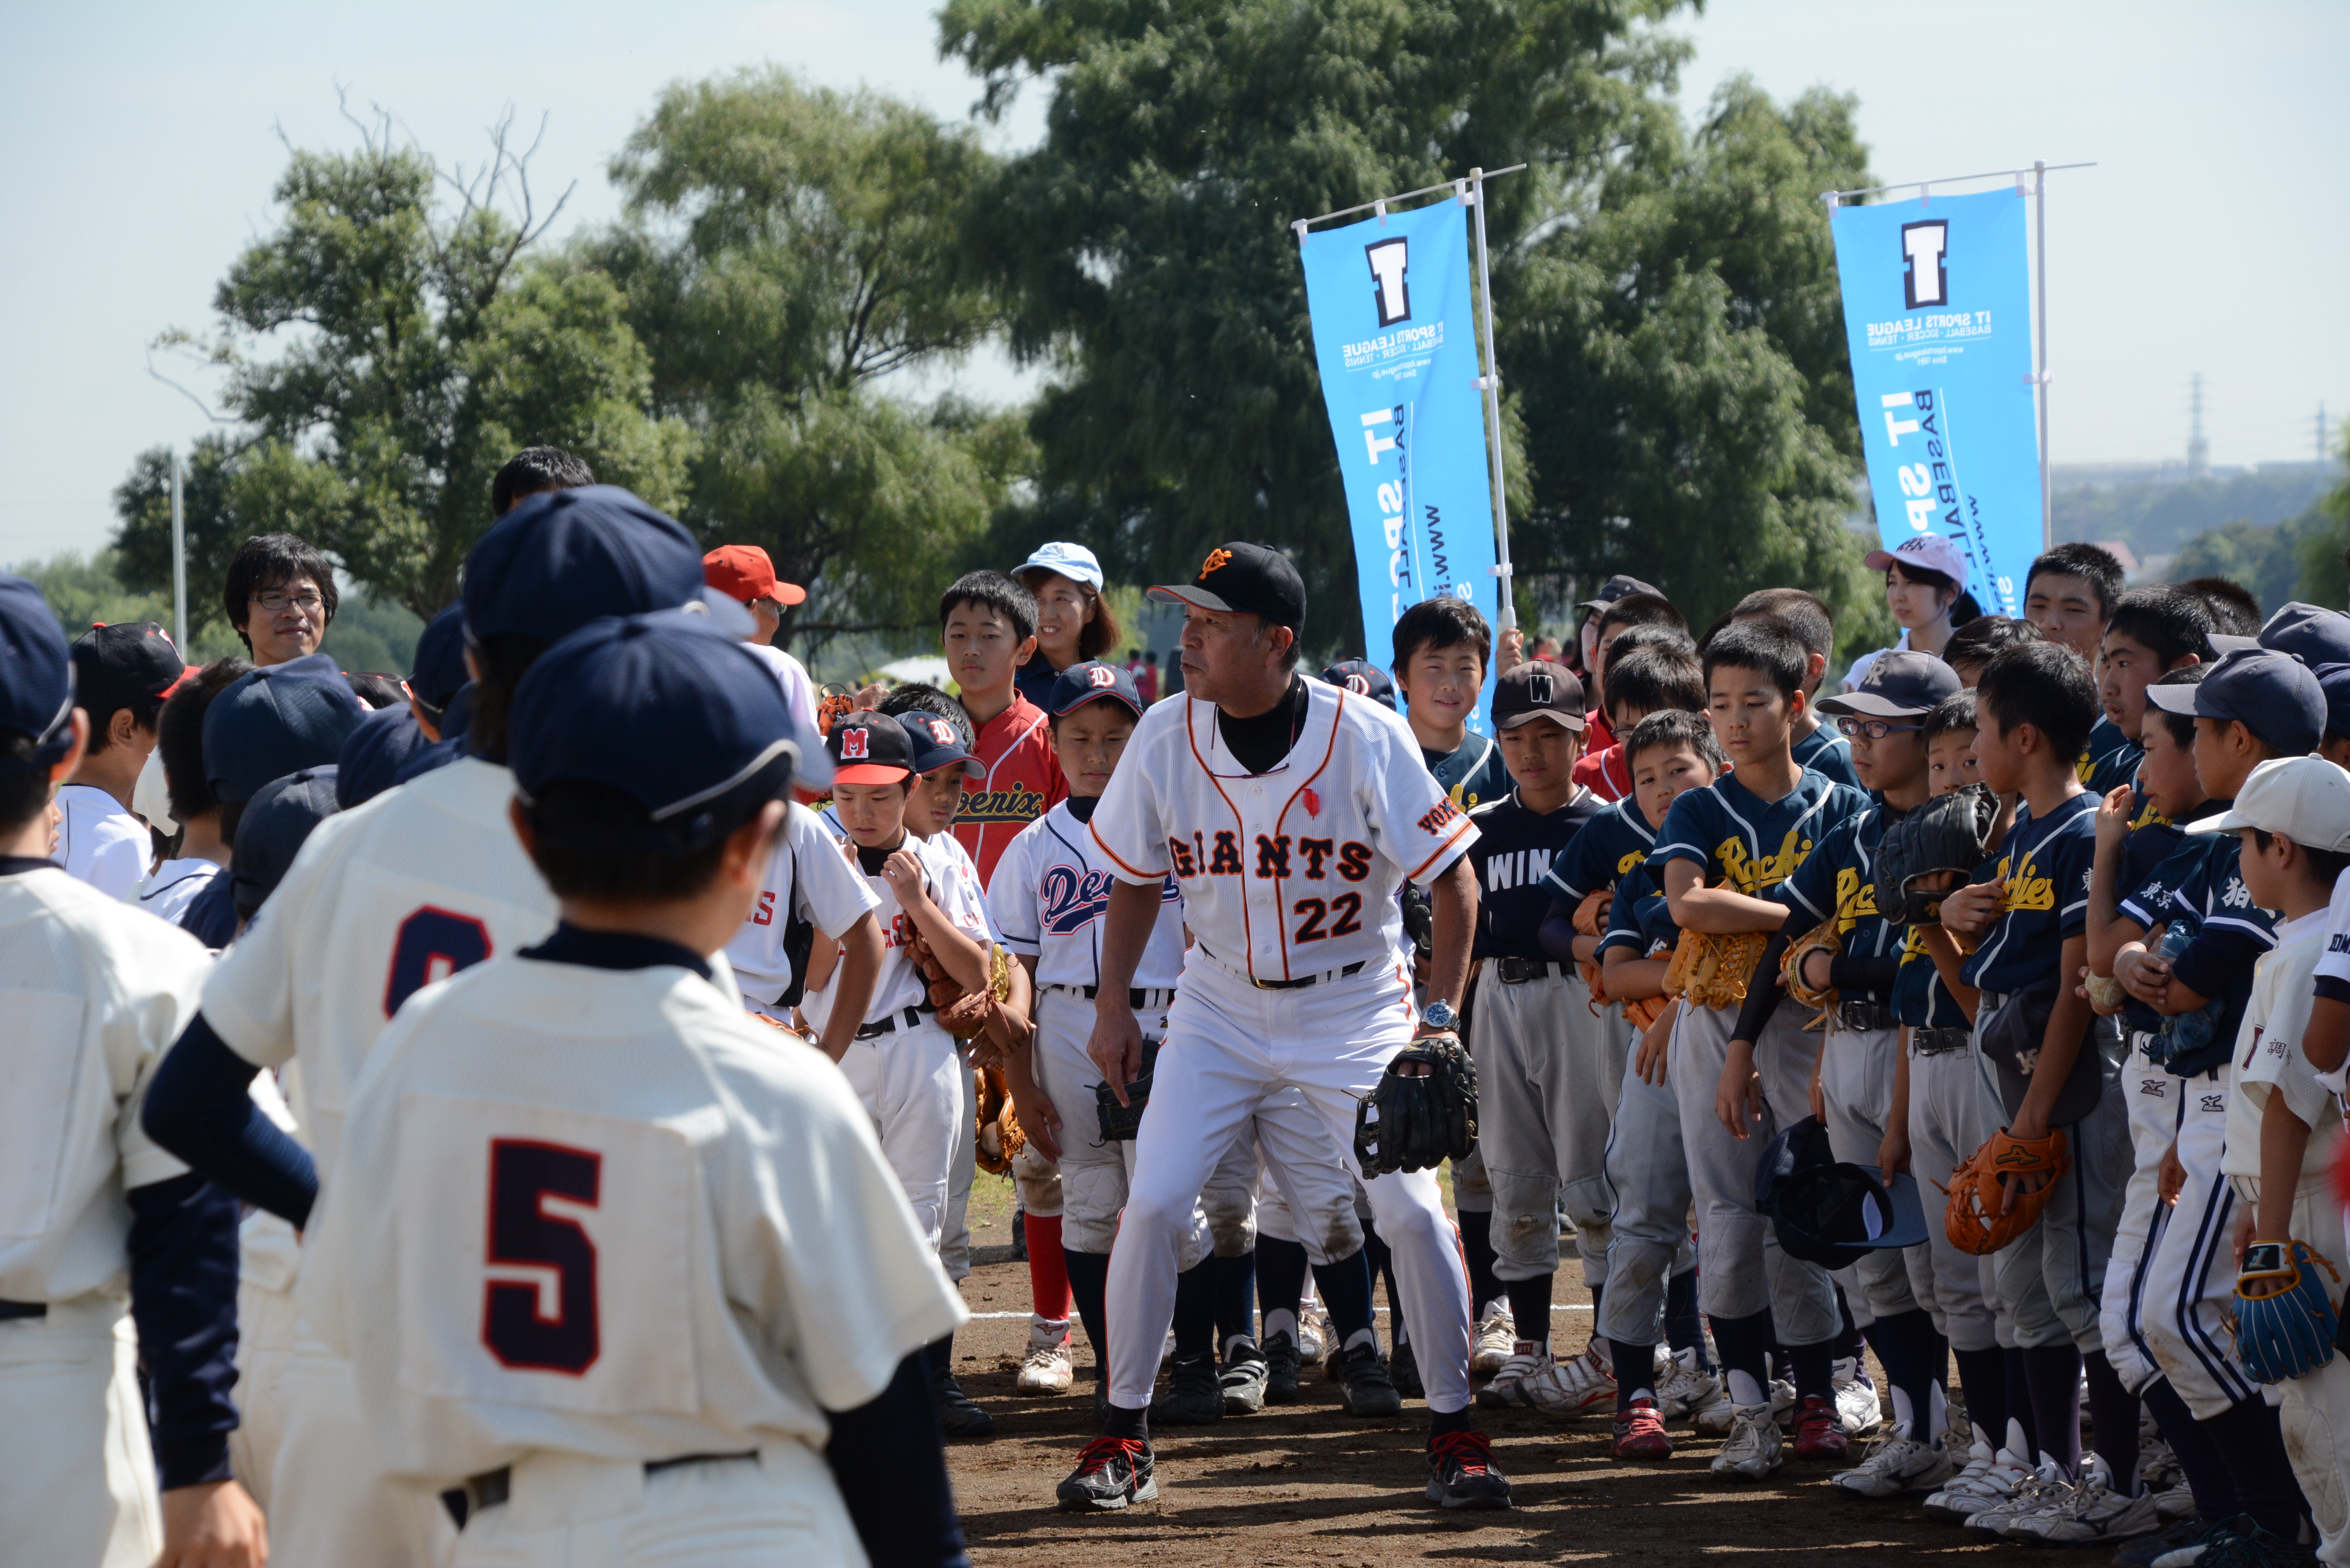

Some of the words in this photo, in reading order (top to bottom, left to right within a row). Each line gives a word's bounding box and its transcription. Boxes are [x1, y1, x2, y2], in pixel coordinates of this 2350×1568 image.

[1088, 665, 1116, 688] D
[1529, 674, 1553, 704] W
[840, 728, 869, 759] M
[929, 719, 955, 745] D
[1169, 829, 1374, 882] GIANTS
[1488, 848, 1563, 892] WIN
[1293, 891, 1362, 945] 22
[481, 1135, 604, 1380] 5
